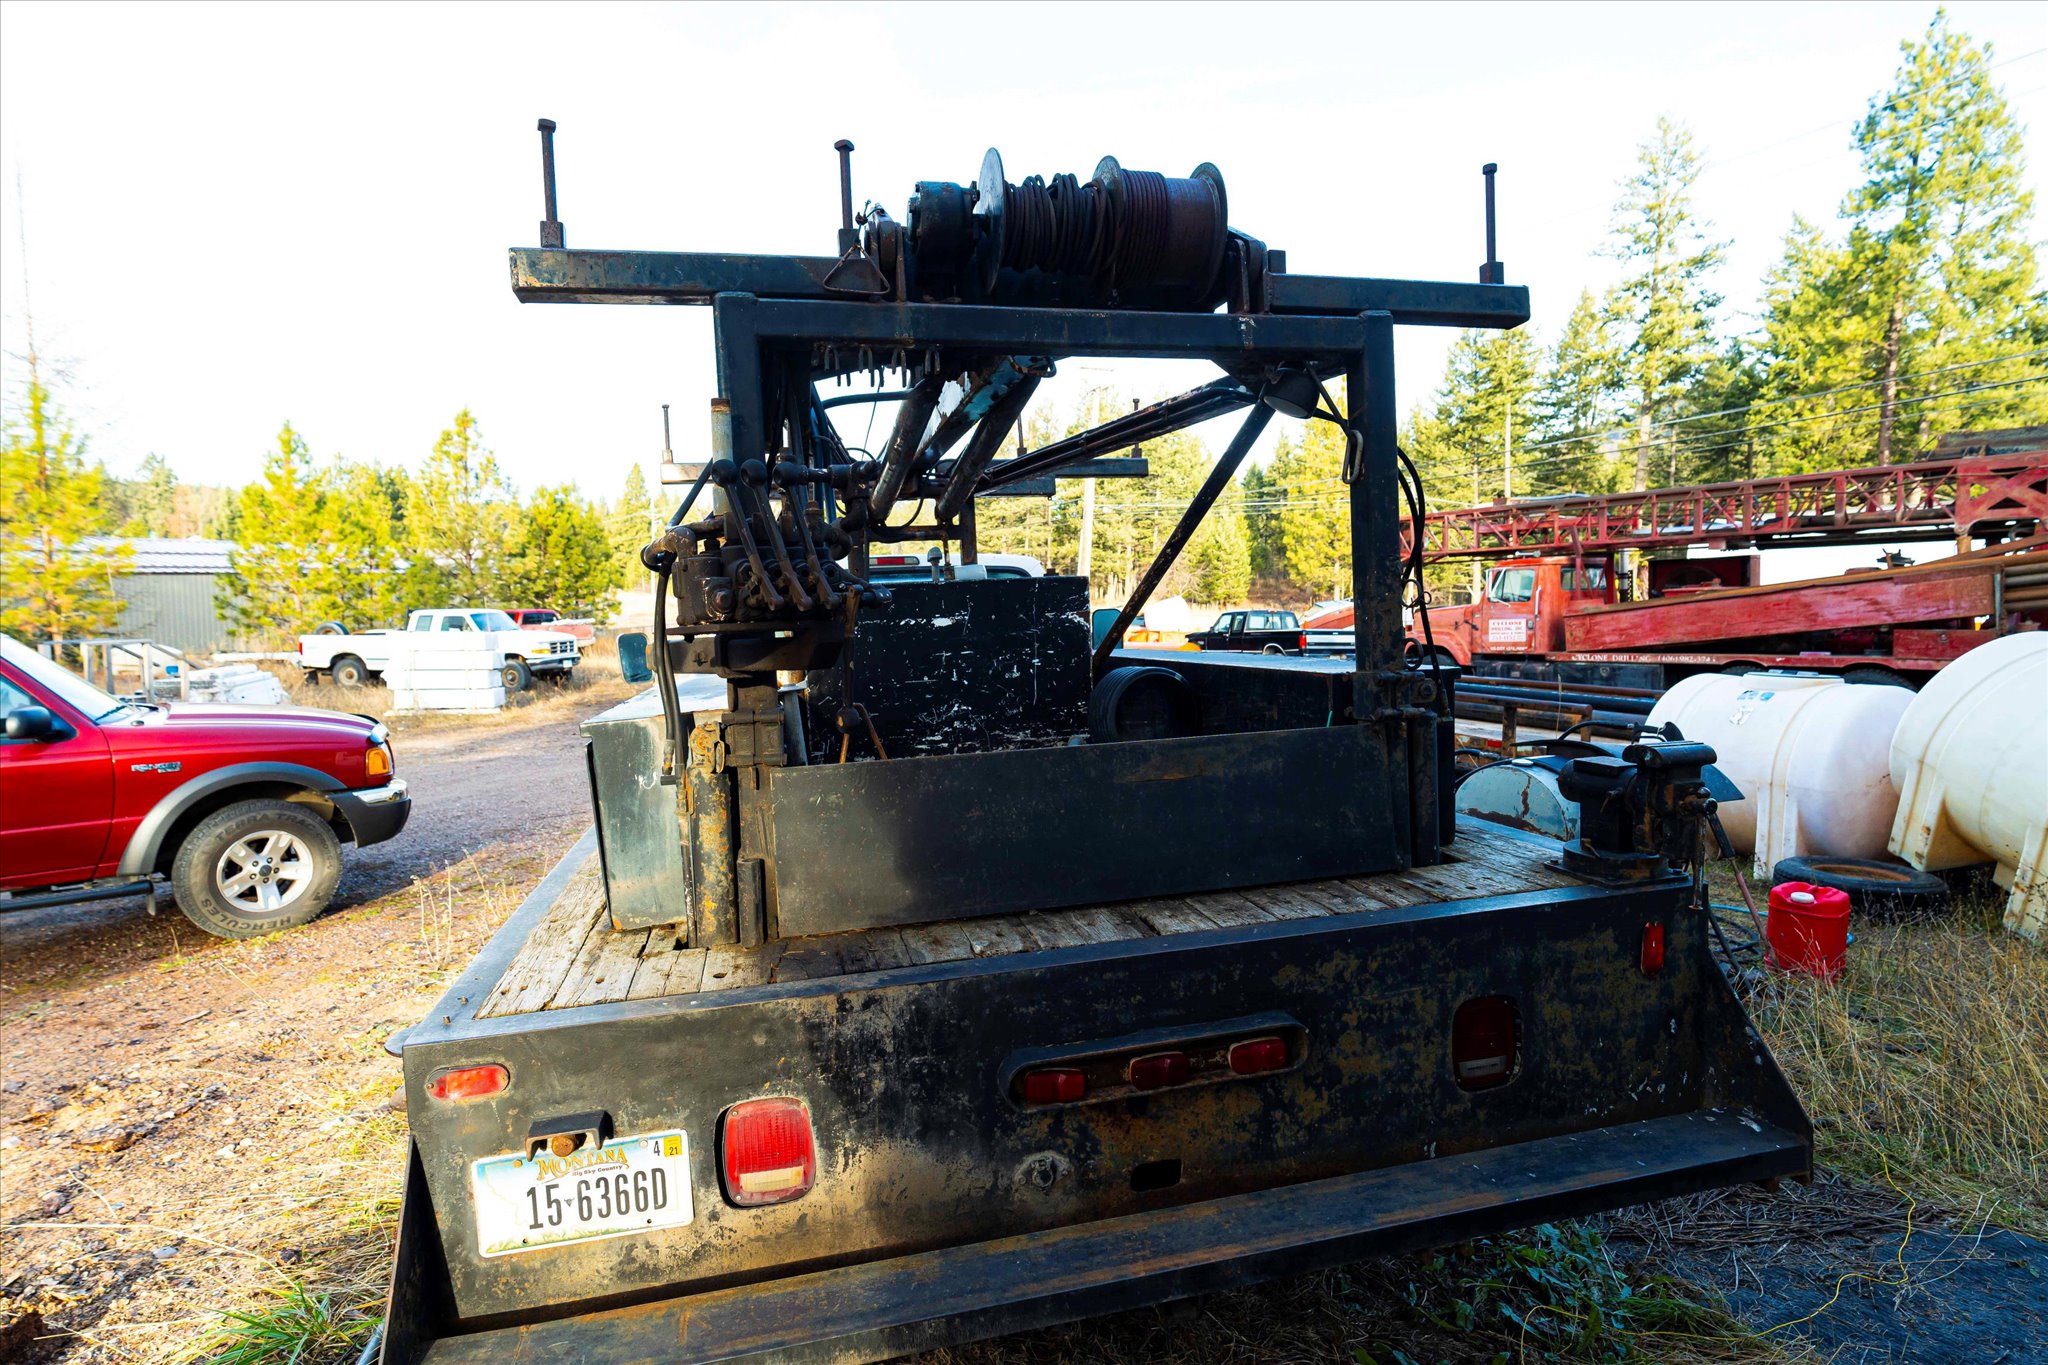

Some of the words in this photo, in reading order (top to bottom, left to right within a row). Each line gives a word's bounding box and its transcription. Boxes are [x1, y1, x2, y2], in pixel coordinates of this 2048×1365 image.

[215, 813, 270, 841] TERRA
[201, 898, 292, 931] HERCULES
[653, 1140, 661, 1157] 4
[669, 1146, 679, 1156] 21
[535, 1146, 630, 1182] MONTANA
[597, 1165, 623, 1173] Country
